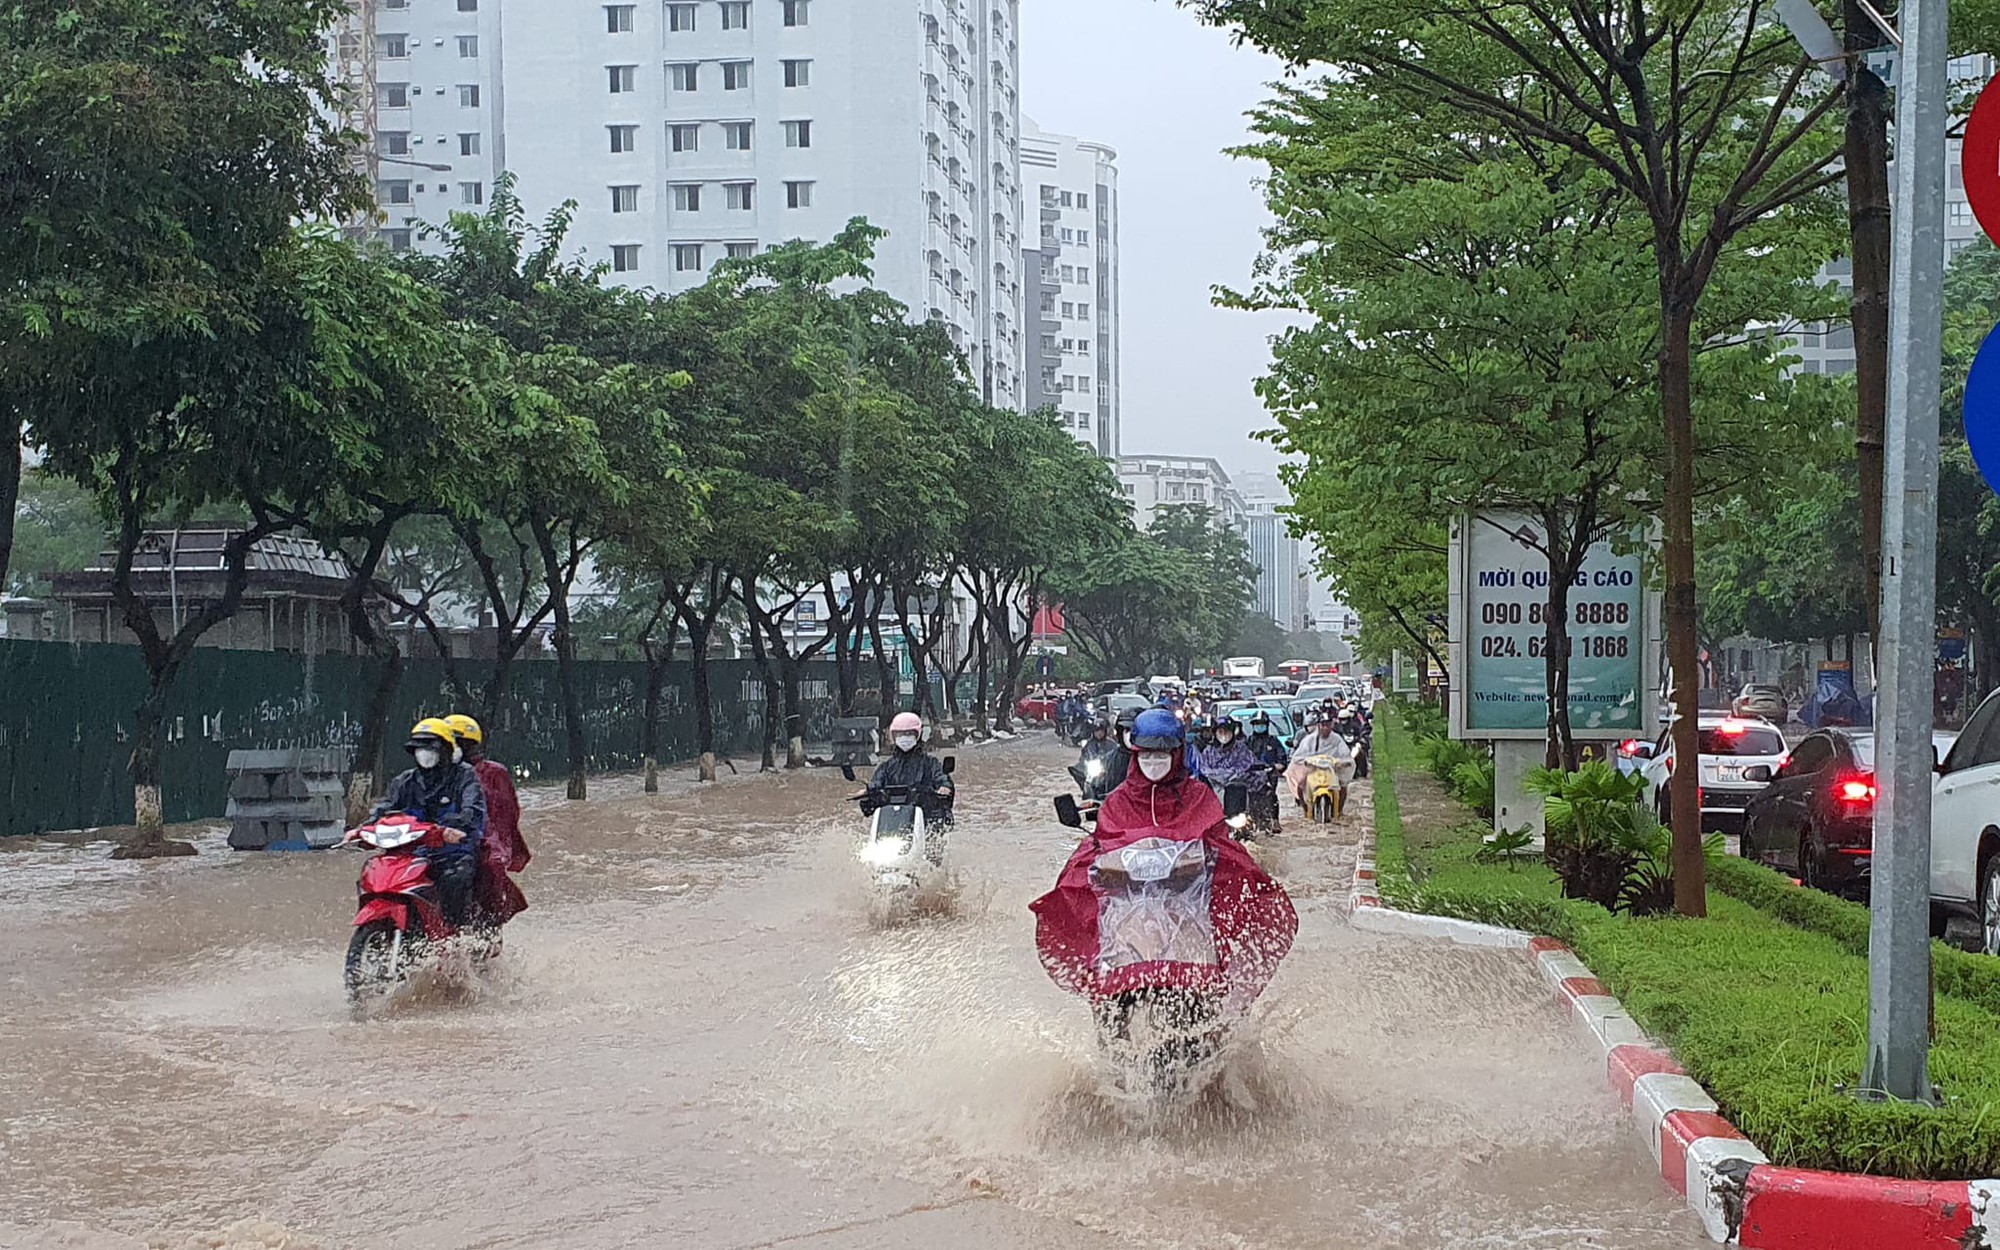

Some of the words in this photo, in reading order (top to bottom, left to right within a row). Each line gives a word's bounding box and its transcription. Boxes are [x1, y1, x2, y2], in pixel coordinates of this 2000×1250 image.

[1479, 567, 1515, 587] MỜI
[1522, 571, 1587, 589] QUG
[1593, 566, 1633, 587] CÁO
[1482, 603, 1521, 624] 090
[1529, 603, 1568, 624] 80
[1575, 603, 1629, 624] 8888
[1481, 636, 1522, 657] 024.
[1582, 636, 1628, 657] 1868
[1474, 691, 1520, 702] Website:
